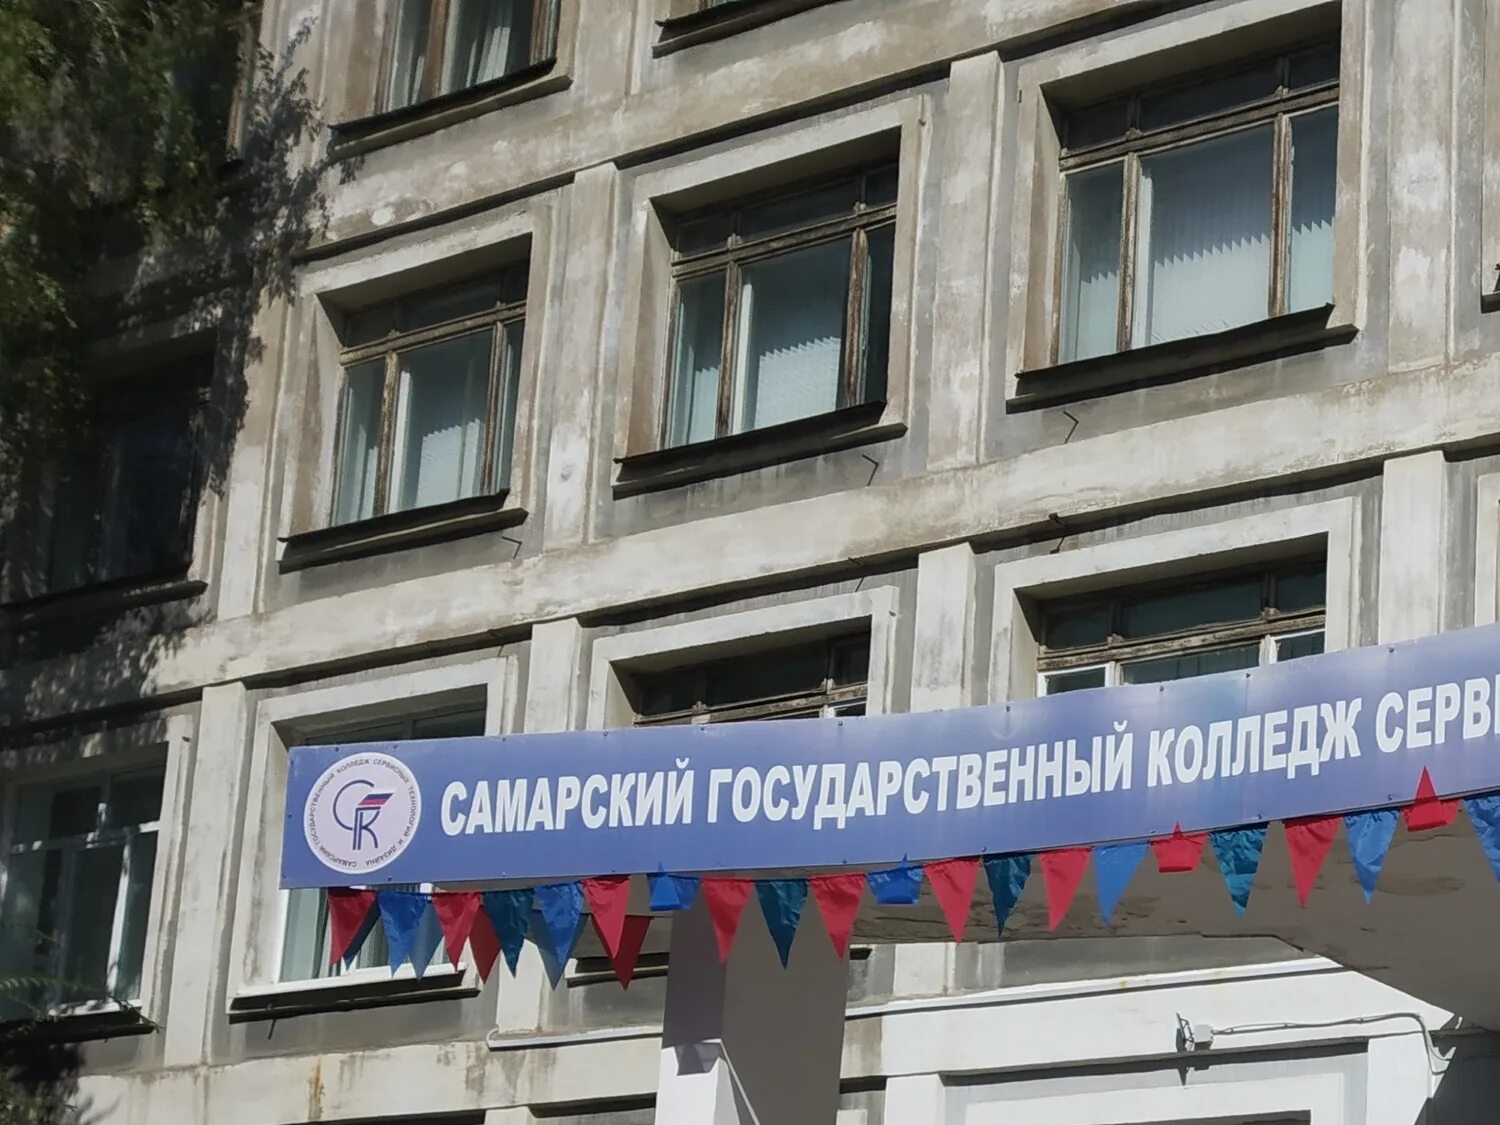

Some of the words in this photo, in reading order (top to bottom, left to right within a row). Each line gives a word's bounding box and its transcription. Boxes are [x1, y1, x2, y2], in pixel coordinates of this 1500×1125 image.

[441, 758, 695, 836] САМАРСКИЙ
[707, 721, 1134, 830] ГОСУДАРСТВЕННЫЙ
[1147, 697, 1362, 787] КОЛЛЕДЖ
